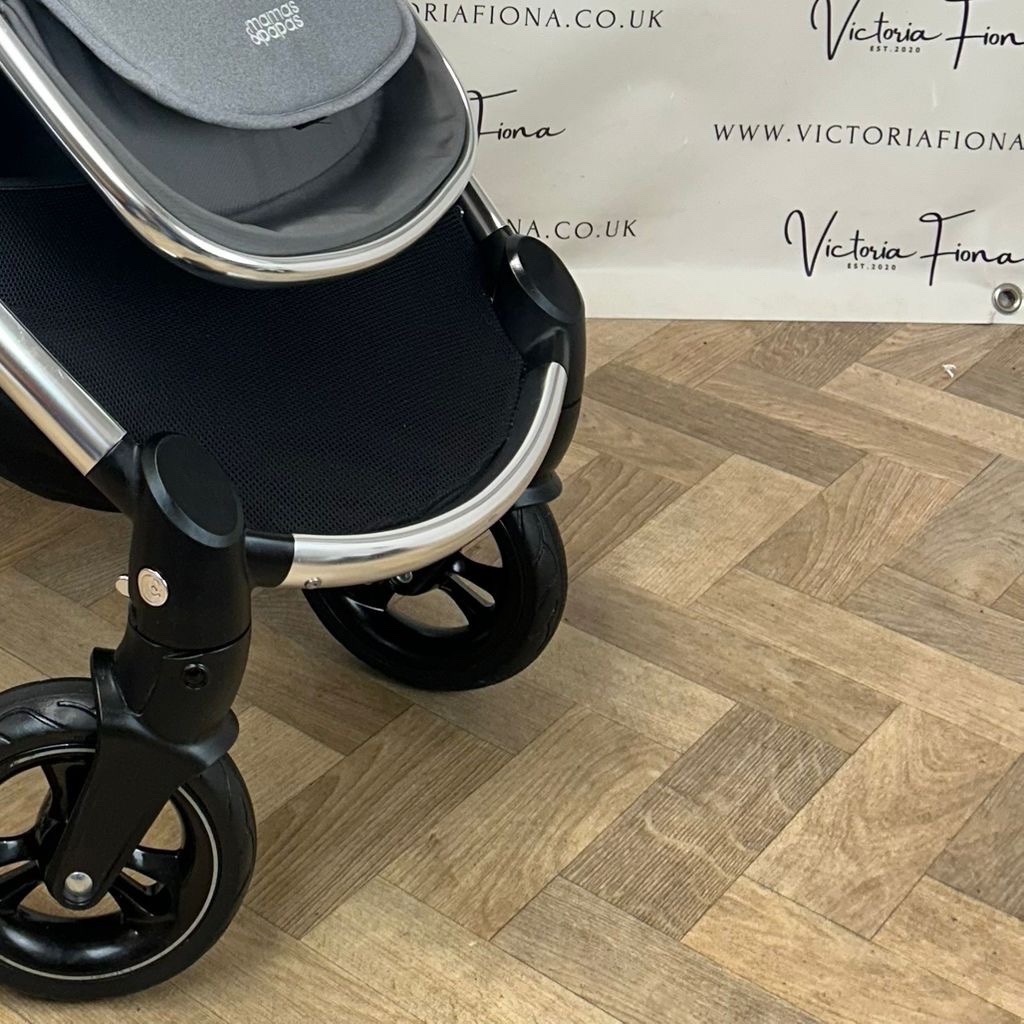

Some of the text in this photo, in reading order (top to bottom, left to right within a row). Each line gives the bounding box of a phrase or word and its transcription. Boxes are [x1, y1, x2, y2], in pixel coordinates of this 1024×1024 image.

[244, 0, 299, 34] mamas
[784, 209, 1024, 286] Victoria Fiona
